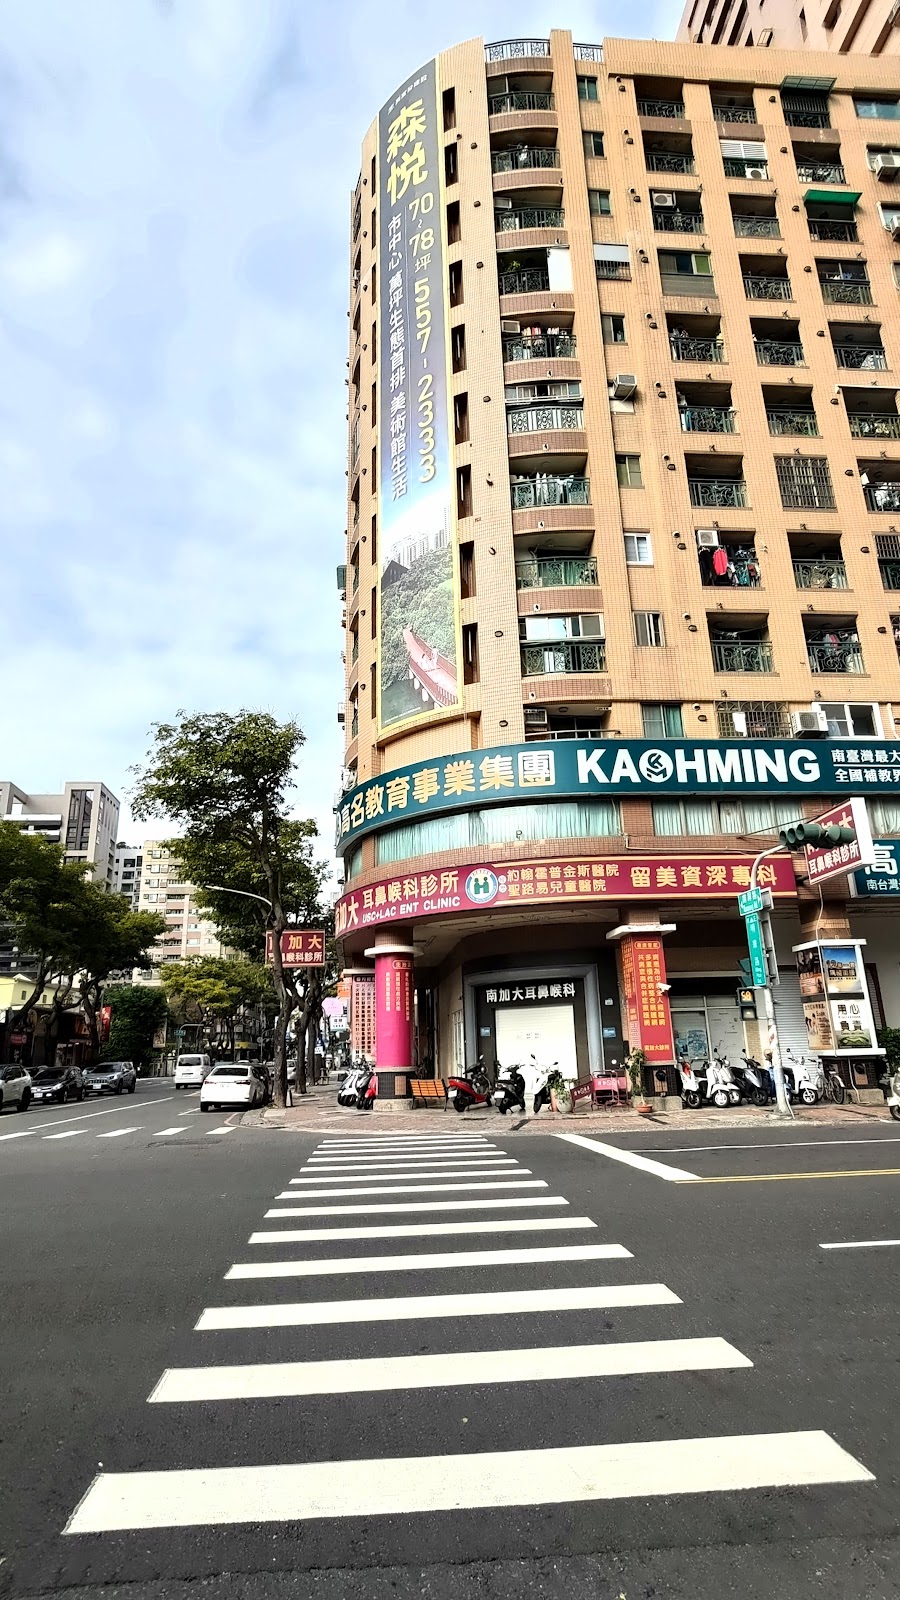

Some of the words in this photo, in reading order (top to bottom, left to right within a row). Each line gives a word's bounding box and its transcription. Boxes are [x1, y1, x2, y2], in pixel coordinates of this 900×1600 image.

[388, 213, 402, 270] 市中心
[414, 277, 437, 483] 557-2333
[340, 749, 555, 837] 高名教育事業集團
[506, 863, 620, 883] 約翰霍普金斯醫院
[808, 840, 859, 875] 耳鼻喉科診所
[362, 870, 459, 909] 耳鼻喉科診所
[507, 879, 607, 897] 聖路易兒童醫院
[630, 864, 778, 889] 留美資深專科
[362, 906, 396, 923] USC+LAC
[399, 902, 420, 915] ENT
[423, 896, 461, 910] CLINIC
[486, 983, 575, 1003] 南加大耳鼻喉科
